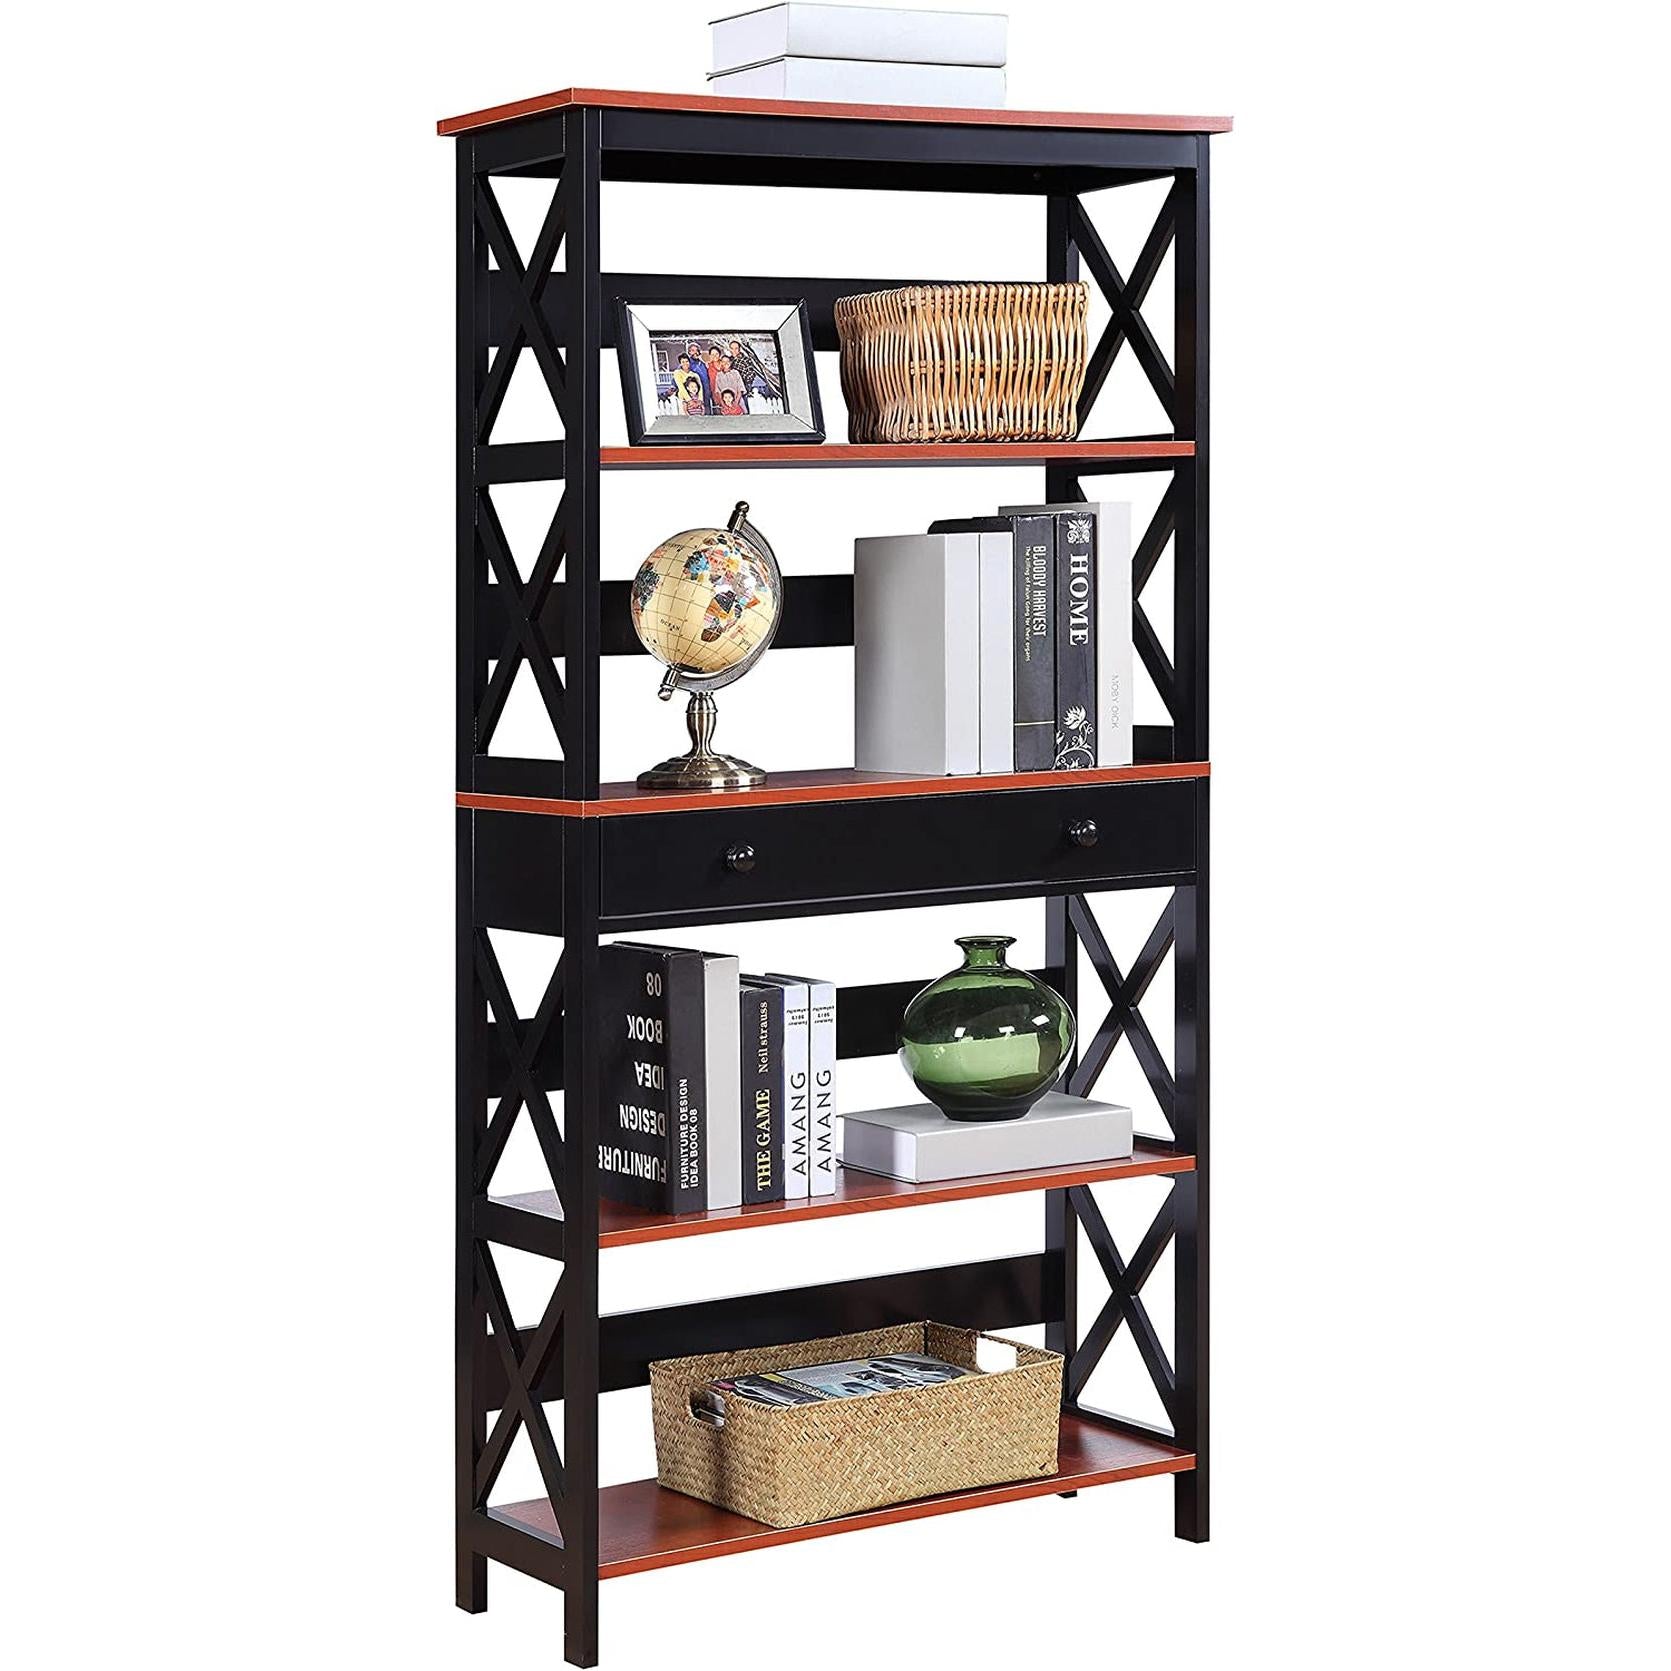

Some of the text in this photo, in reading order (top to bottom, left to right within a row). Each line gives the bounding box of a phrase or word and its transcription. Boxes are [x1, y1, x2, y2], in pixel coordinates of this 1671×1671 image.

[1032, 545, 1047, 637] BLOODY HARVEST
[1069, 553, 1089, 646] HOME
[1111, 674, 1120, 729] MOBY DICK
[646, 972, 662, 997] 08
[626, 1014, 663, 1044] BOOK
[634, 1061, 665, 1090] IDEA
[755, 1001, 771, 1191] THE GAME Neil strauss
[619, 1104, 666, 1137] DESIGN
[679, 1079, 689, 1190] FURNITURE DESIGN
[689, 1108, 699, 1188] IDEA BOOK 08
[790, 1072, 807, 1176] AMANG
[816, 1069, 832, 1172] AMANG
